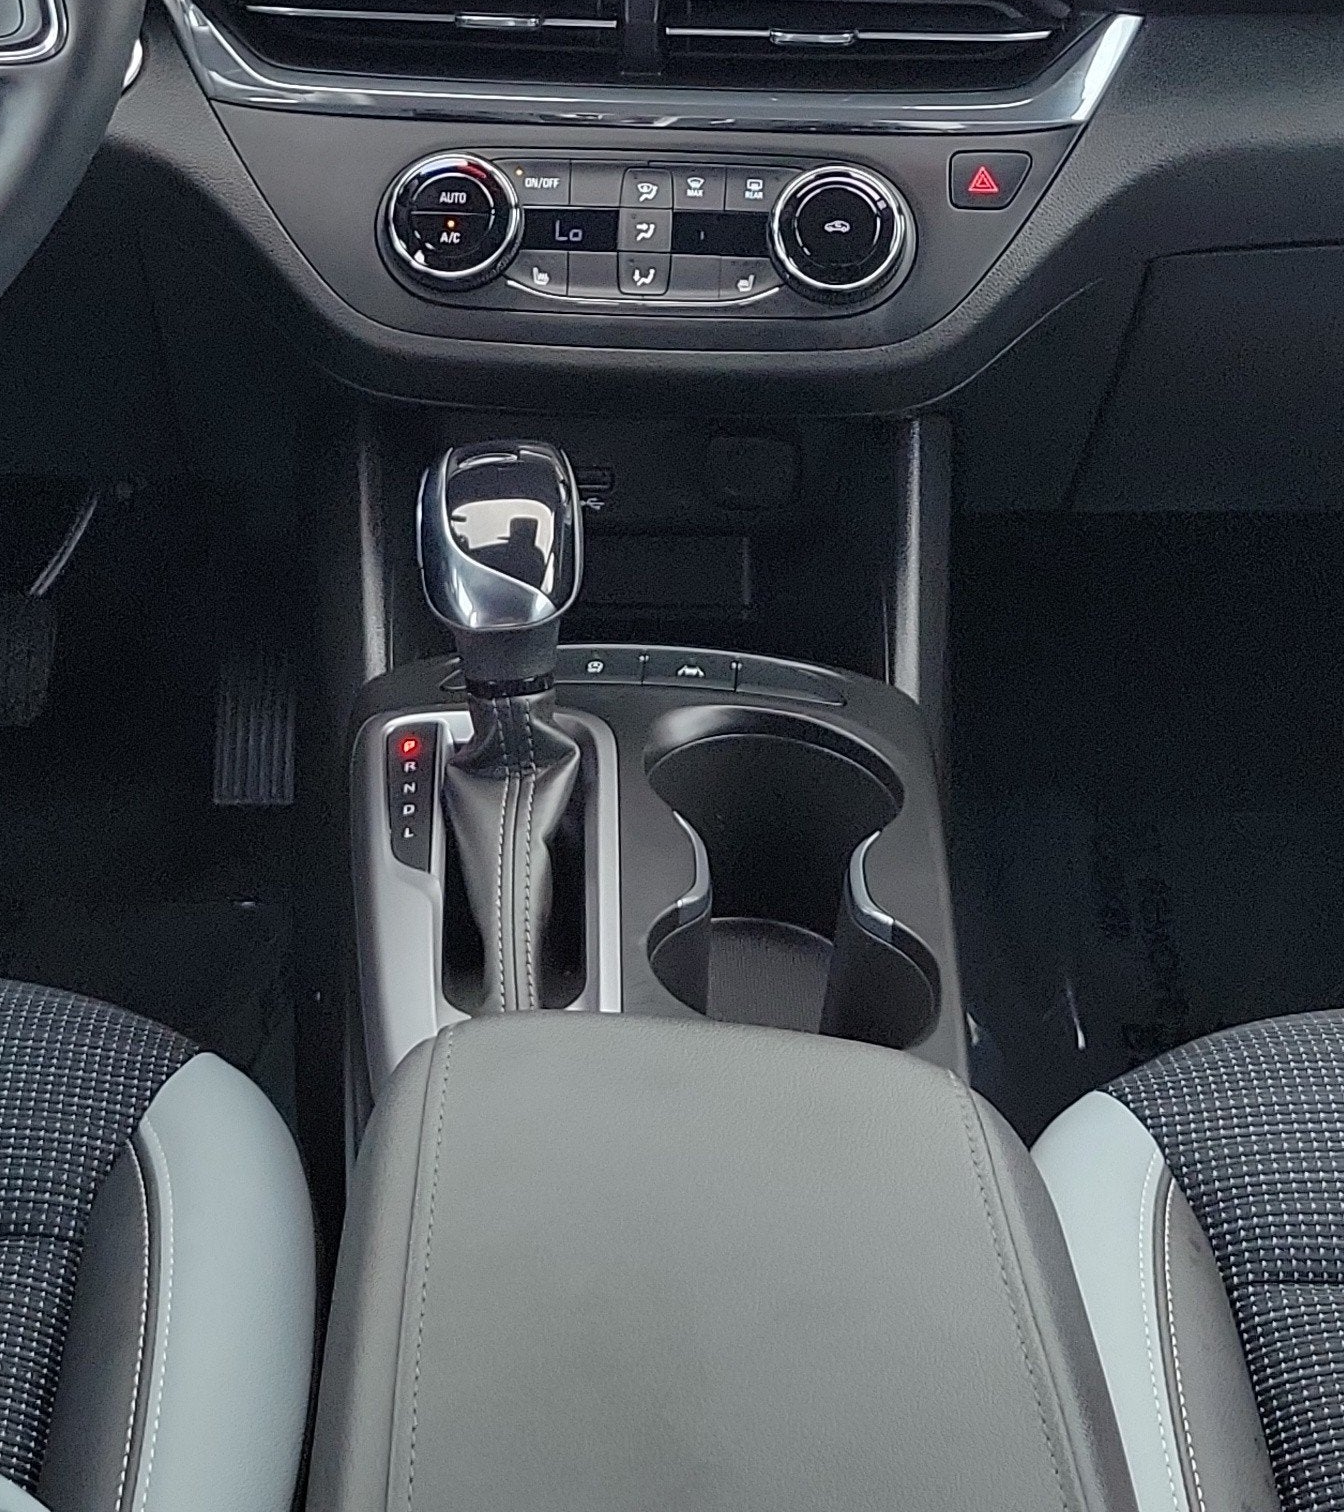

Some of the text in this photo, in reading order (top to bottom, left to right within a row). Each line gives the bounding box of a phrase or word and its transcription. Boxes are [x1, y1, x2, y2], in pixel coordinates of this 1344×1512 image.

[524, 177, 560, 189] ON/OFF
[439, 191, 467, 204] AUTO
[744, 191, 764, 199] REAR
[439, 231, 461, 244] A/C
[403, 760, 417, 773] R
[403, 781, 416, 794] N
[402, 803, 416, 816] D
[403, 827, 415, 839] L
